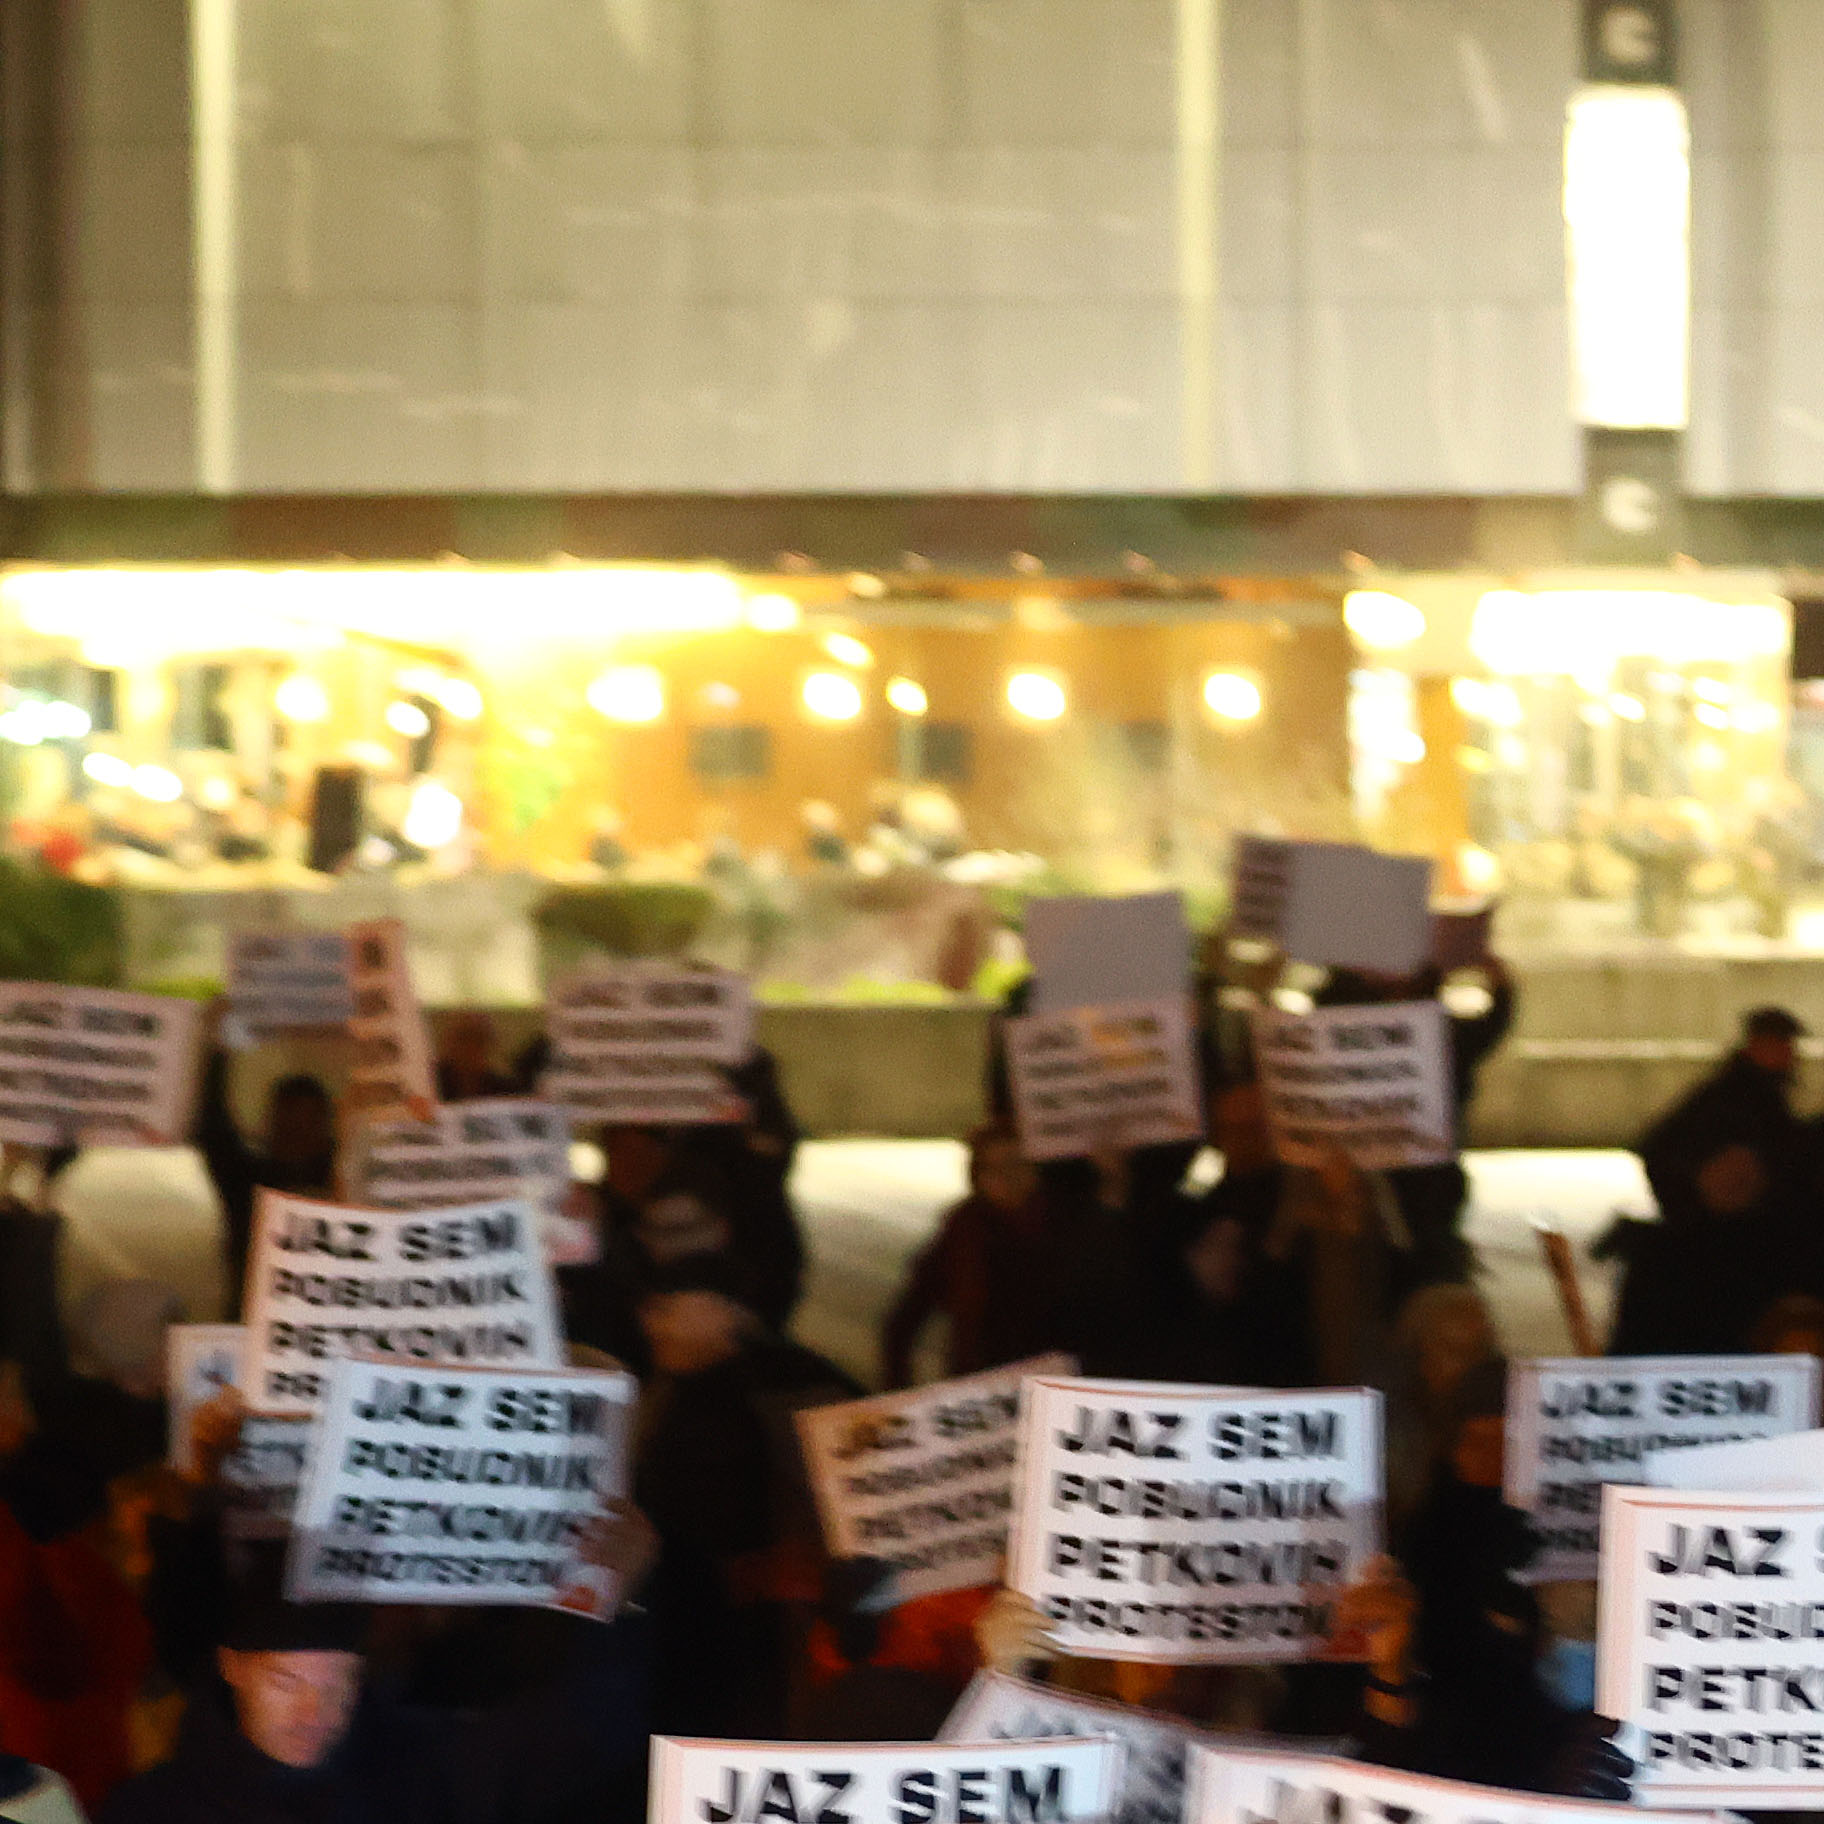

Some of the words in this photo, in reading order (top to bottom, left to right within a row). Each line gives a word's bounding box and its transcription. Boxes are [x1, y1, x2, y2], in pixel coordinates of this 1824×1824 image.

[277, 1212, 377, 1262] JAZ
[399, 1210, 521, 1263] SEM
[274, 1265, 526, 1310] POBUDNIK
[354, 1374, 466, 1430] JAZ
[486, 1385, 606, 1435] SEM
[1540, 1378, 1639, 1418] JAZ
[1660, 1378, 1776, 1416] SEM
[1056, 1406, 1188, 1461] JAZ
[1208, 1408, 1346, 1461] SEM
[1052, 1469, 1348, 1520] POBUDNIK
[1049, 1532, 1351, 1587] PETKOVIH
[1645, 1522, 1793, 1578] JAZ
